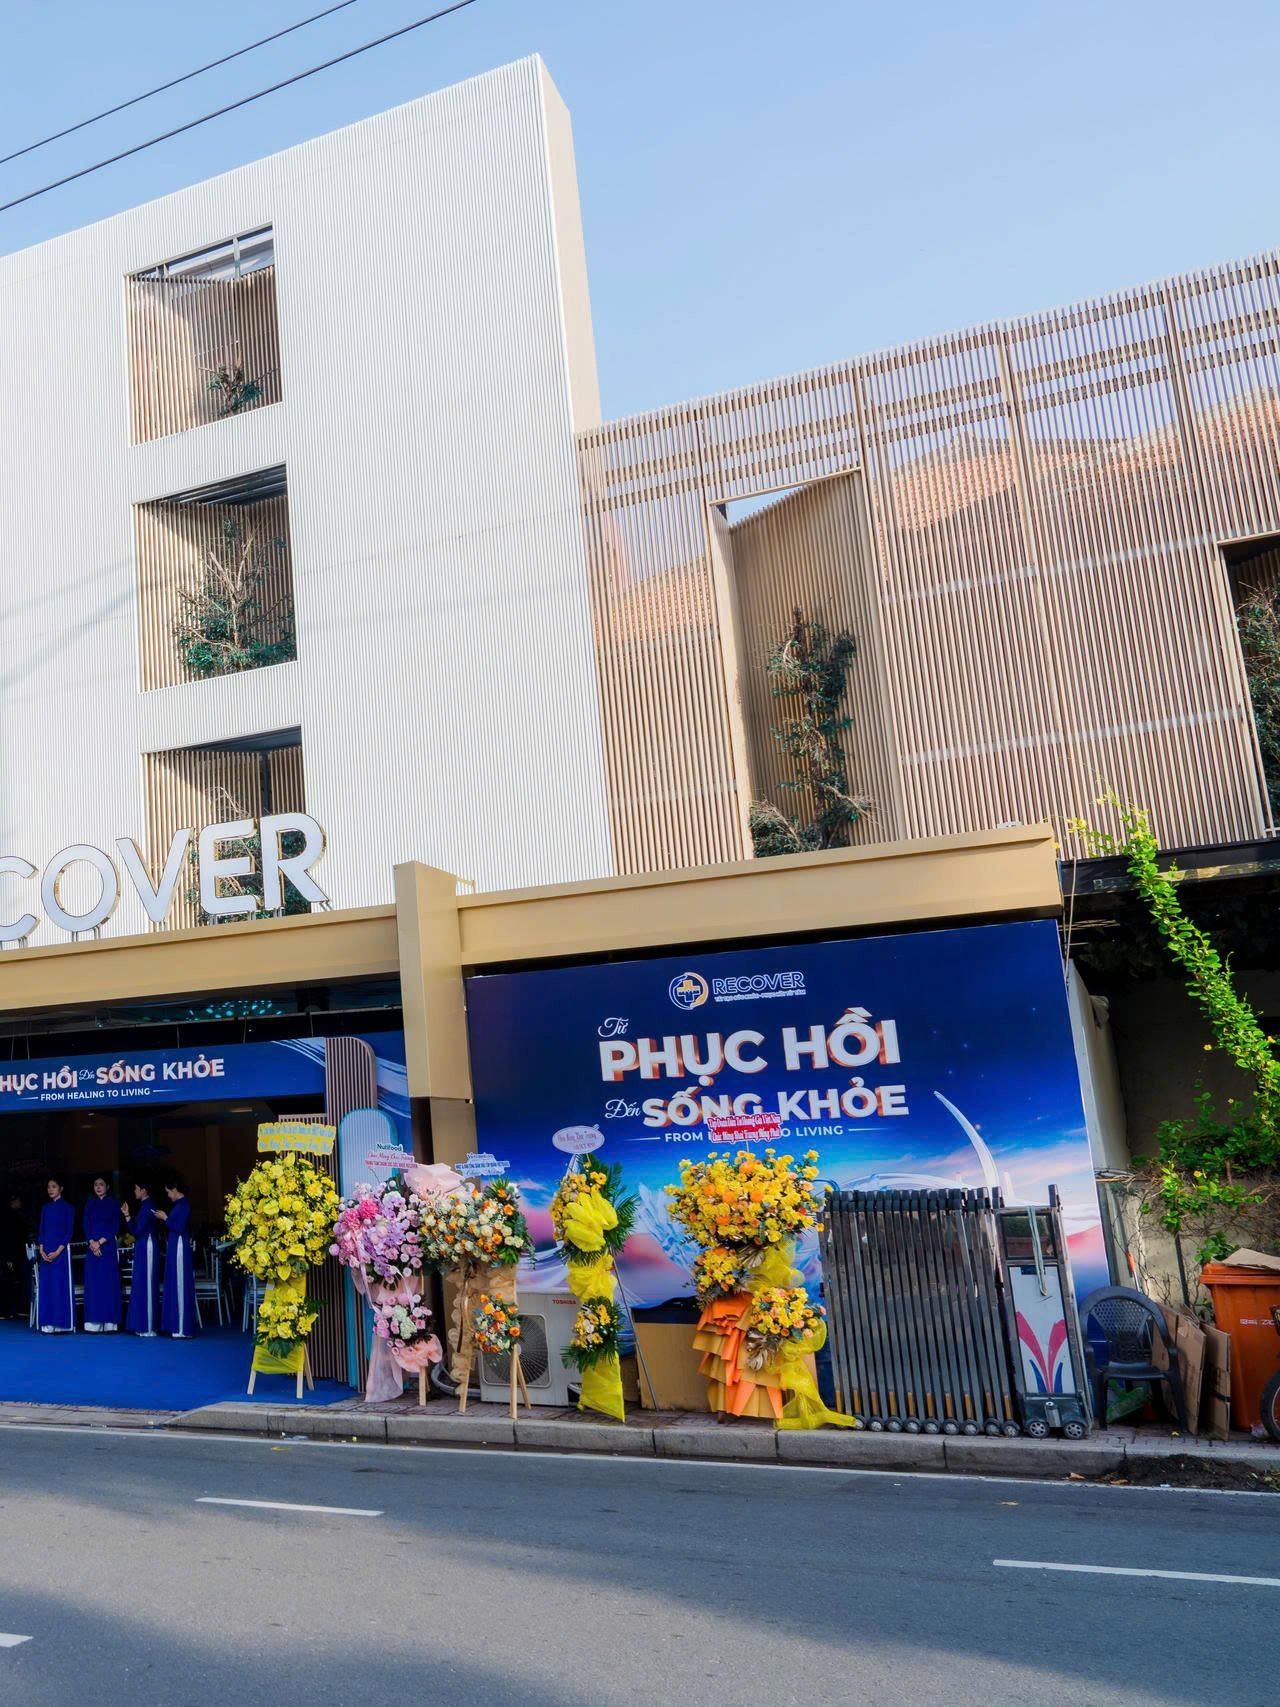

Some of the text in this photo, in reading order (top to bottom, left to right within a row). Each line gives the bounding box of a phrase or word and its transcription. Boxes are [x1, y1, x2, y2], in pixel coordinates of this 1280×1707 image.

[712, 970, 806, 995] RECOVER
[597, 1016, 630, 1038] Từ
[599, 1006, 901, 1087] PHỤC HỒI
[43, 1065, 78, 1090] HỒI
[95, 1059, 156, 1085] SỐNG
[163, 1054, 226, 1081] KHỎE
[40, 1087, 151, 1102] FROM HEALING TO LIVING
[604, 1076, 910, 1128] Đến SỐNG KHỎE
[665, 1132, 703, 1143] FROM
[795, 1125, 844, 1137] LIVING
